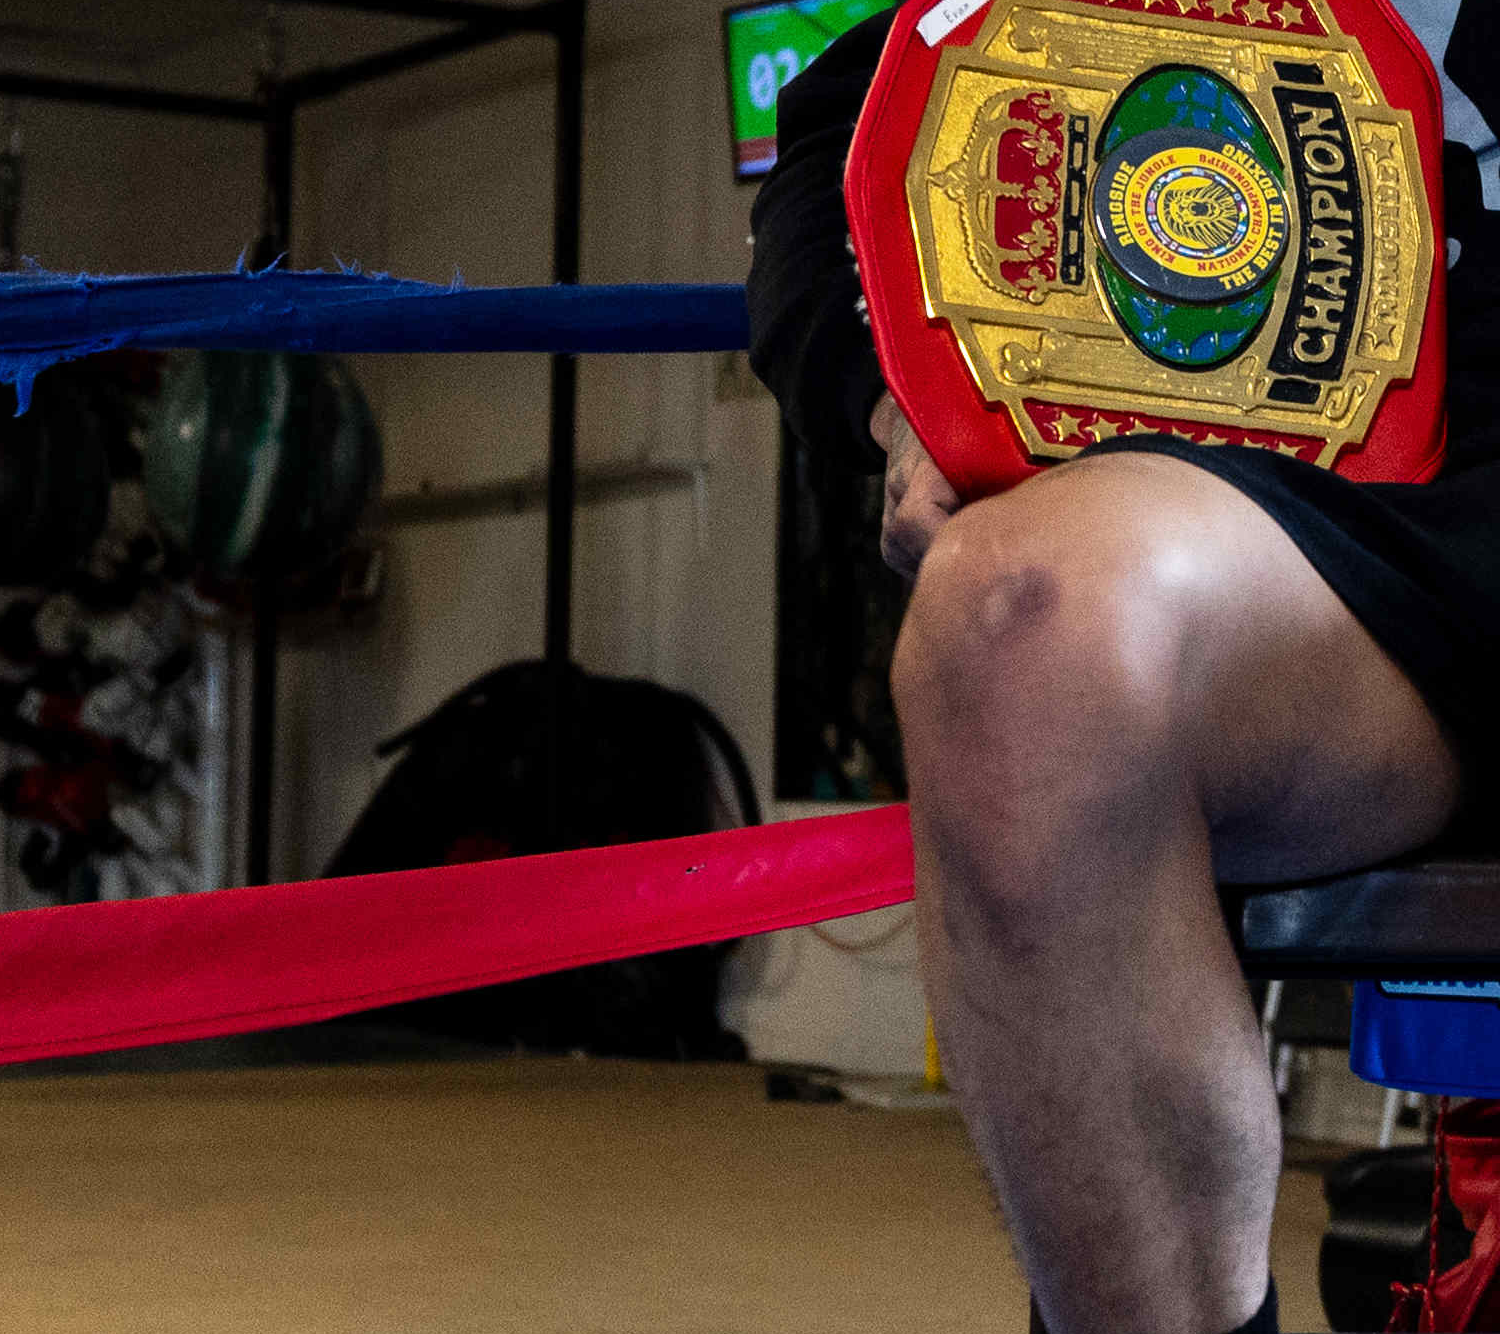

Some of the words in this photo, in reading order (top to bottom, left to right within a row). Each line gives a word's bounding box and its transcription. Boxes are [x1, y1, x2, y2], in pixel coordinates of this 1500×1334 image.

[1136, 154, 1177, 190] JUNGLE
[1221, 143, 1279, 202] BOXING
[1108, 160, 1136, 247] RINGSIDE
[1131, 192, 1142, 217] THE
[1268, 203, 1285, 225] IN
[1133, 218, 1147, 236] OF
[1292, 103, 1354, 364] CHAMPION
[1146, 235, 1176, 266] KING
[1197, 237, 1258, 272] NATIONAL
[1253, 227, 1284, 270] BEST
[1218, 265, 1257, 291] THE
